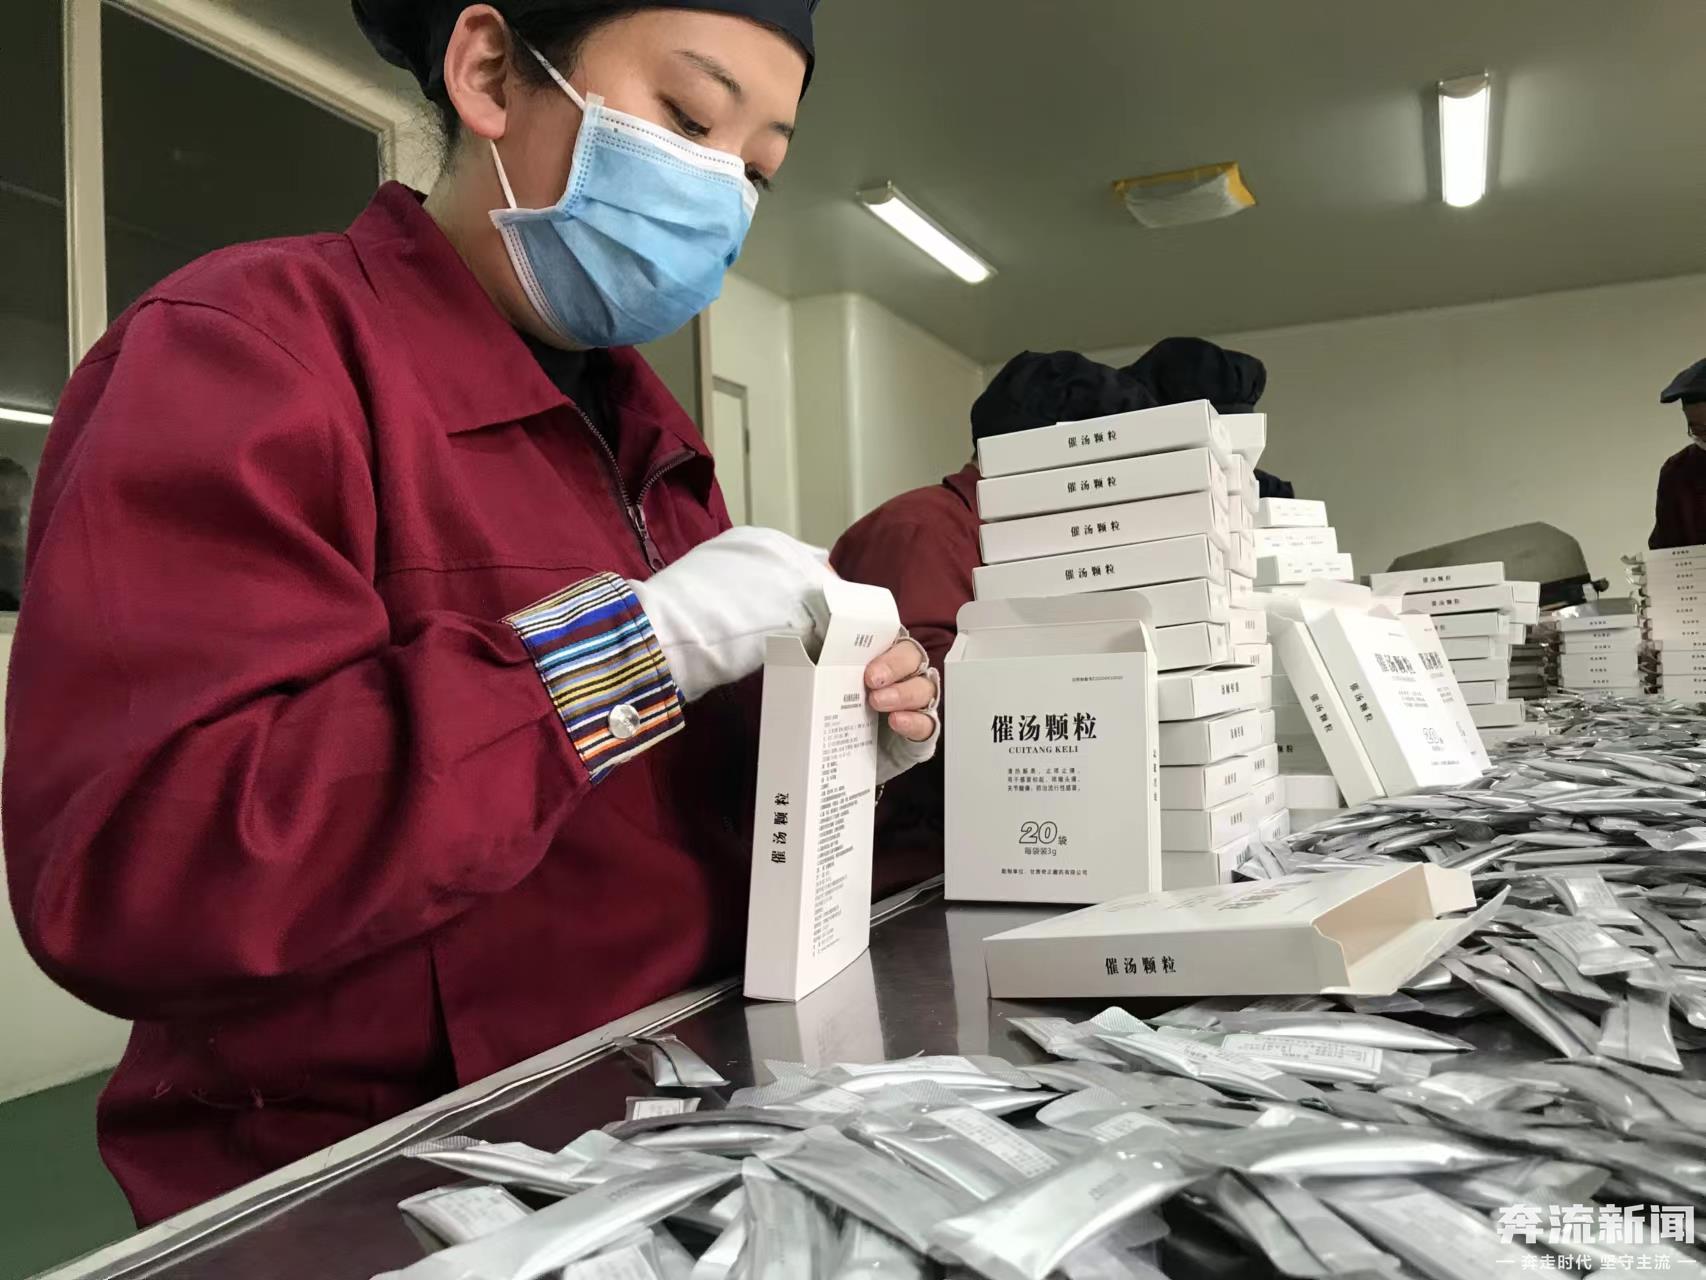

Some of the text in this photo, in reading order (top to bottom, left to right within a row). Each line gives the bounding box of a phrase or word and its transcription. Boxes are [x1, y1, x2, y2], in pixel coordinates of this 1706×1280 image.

[1068, 430, 1118, 448] 催汤颗粒
[1067, 475, 1117, 493] 催汤颗粒
[1070, 520, 1121, 537] 催汤颗粒
[1065, 563, 1116, 581] 催汤颗粒
[991, 712, 1097, 743] 催汤颗粒
[1008, 745, 1079, 754] CUITANG KELI
[770, 792, 790, 866] 催汤颗粒
[1104, 955, 1177, 976] 催汤颗粒
